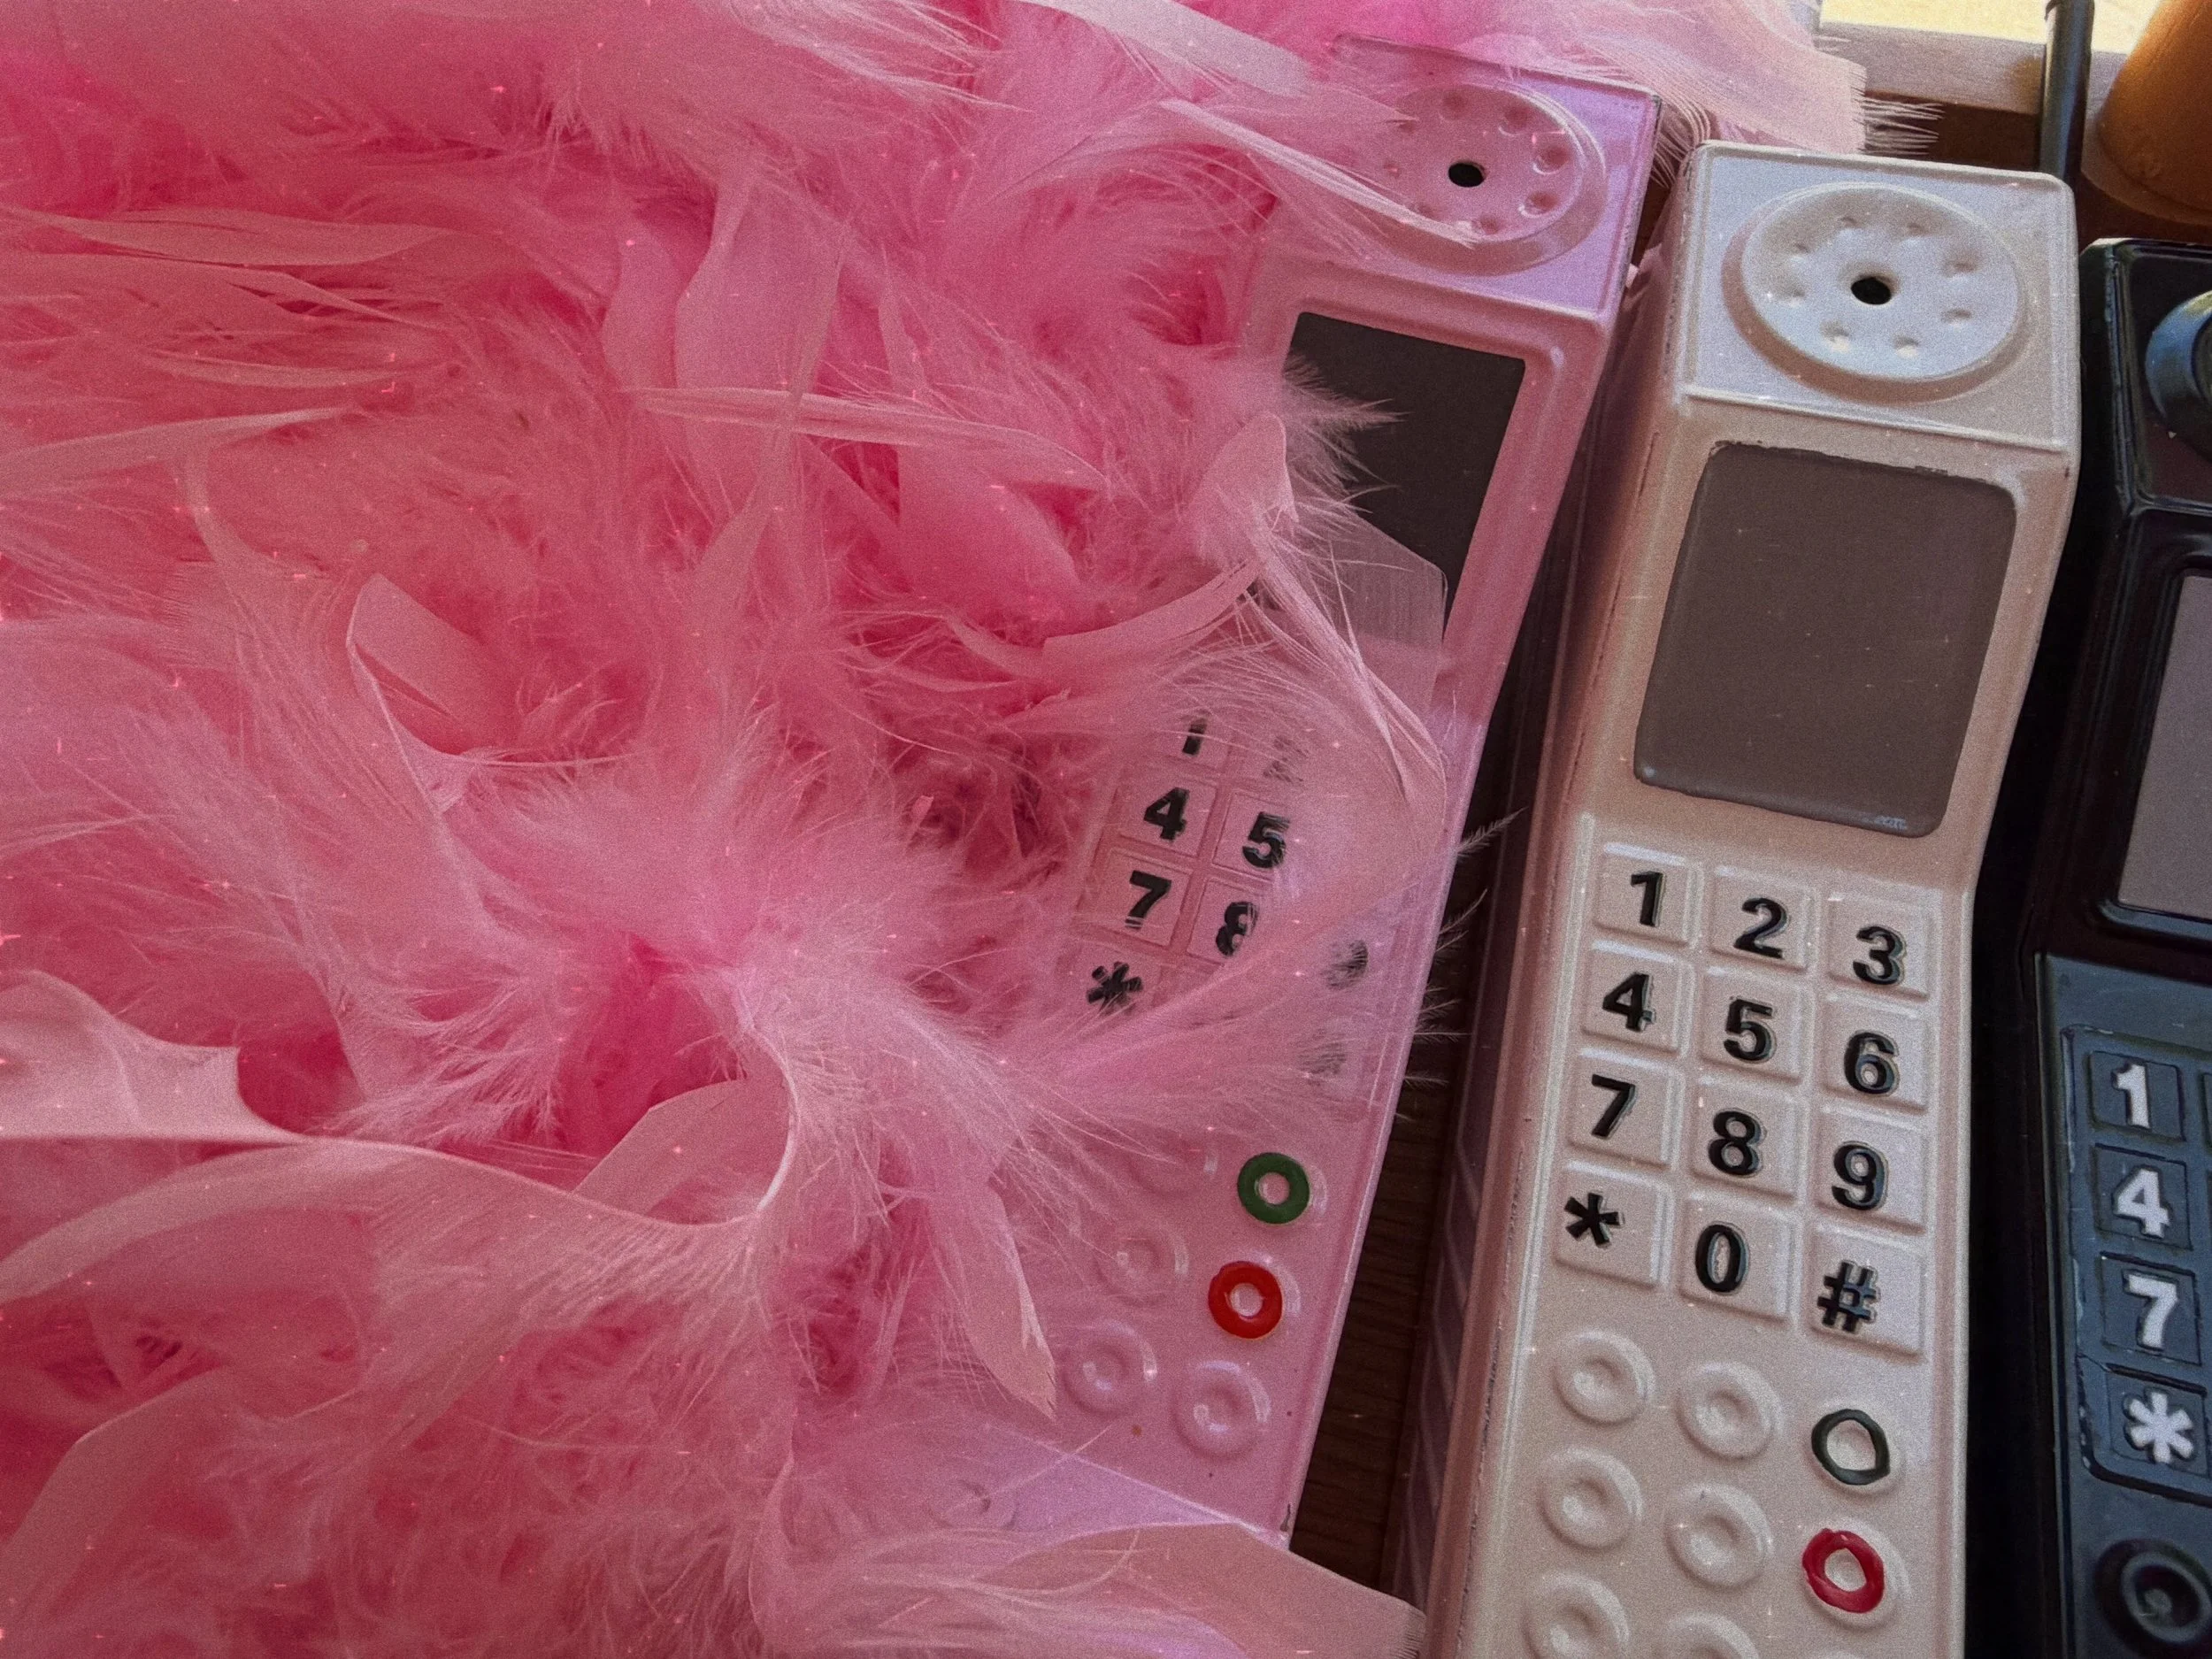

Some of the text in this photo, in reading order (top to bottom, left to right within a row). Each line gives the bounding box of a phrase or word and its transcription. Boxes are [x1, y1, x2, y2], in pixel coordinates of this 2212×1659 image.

[1143, 787, 1290, 868] 4 5
[1125, 870, 1258, 957] 7 8
[1630, 871, 1907, 986] 1 2 3
[1602, 972, 1900, 1095] 4 5 6
[2116, 1063, 2150, 1129] 1
[1592, 1074, 1888, 1211] 7 8 9
[2116, 1167, 2170, 1238] 4
[1694, 1222, 1750, 1294] 0
[1817, 1260, 1879, 1333] #
[2124, 1273, 2178, 1351] 7
